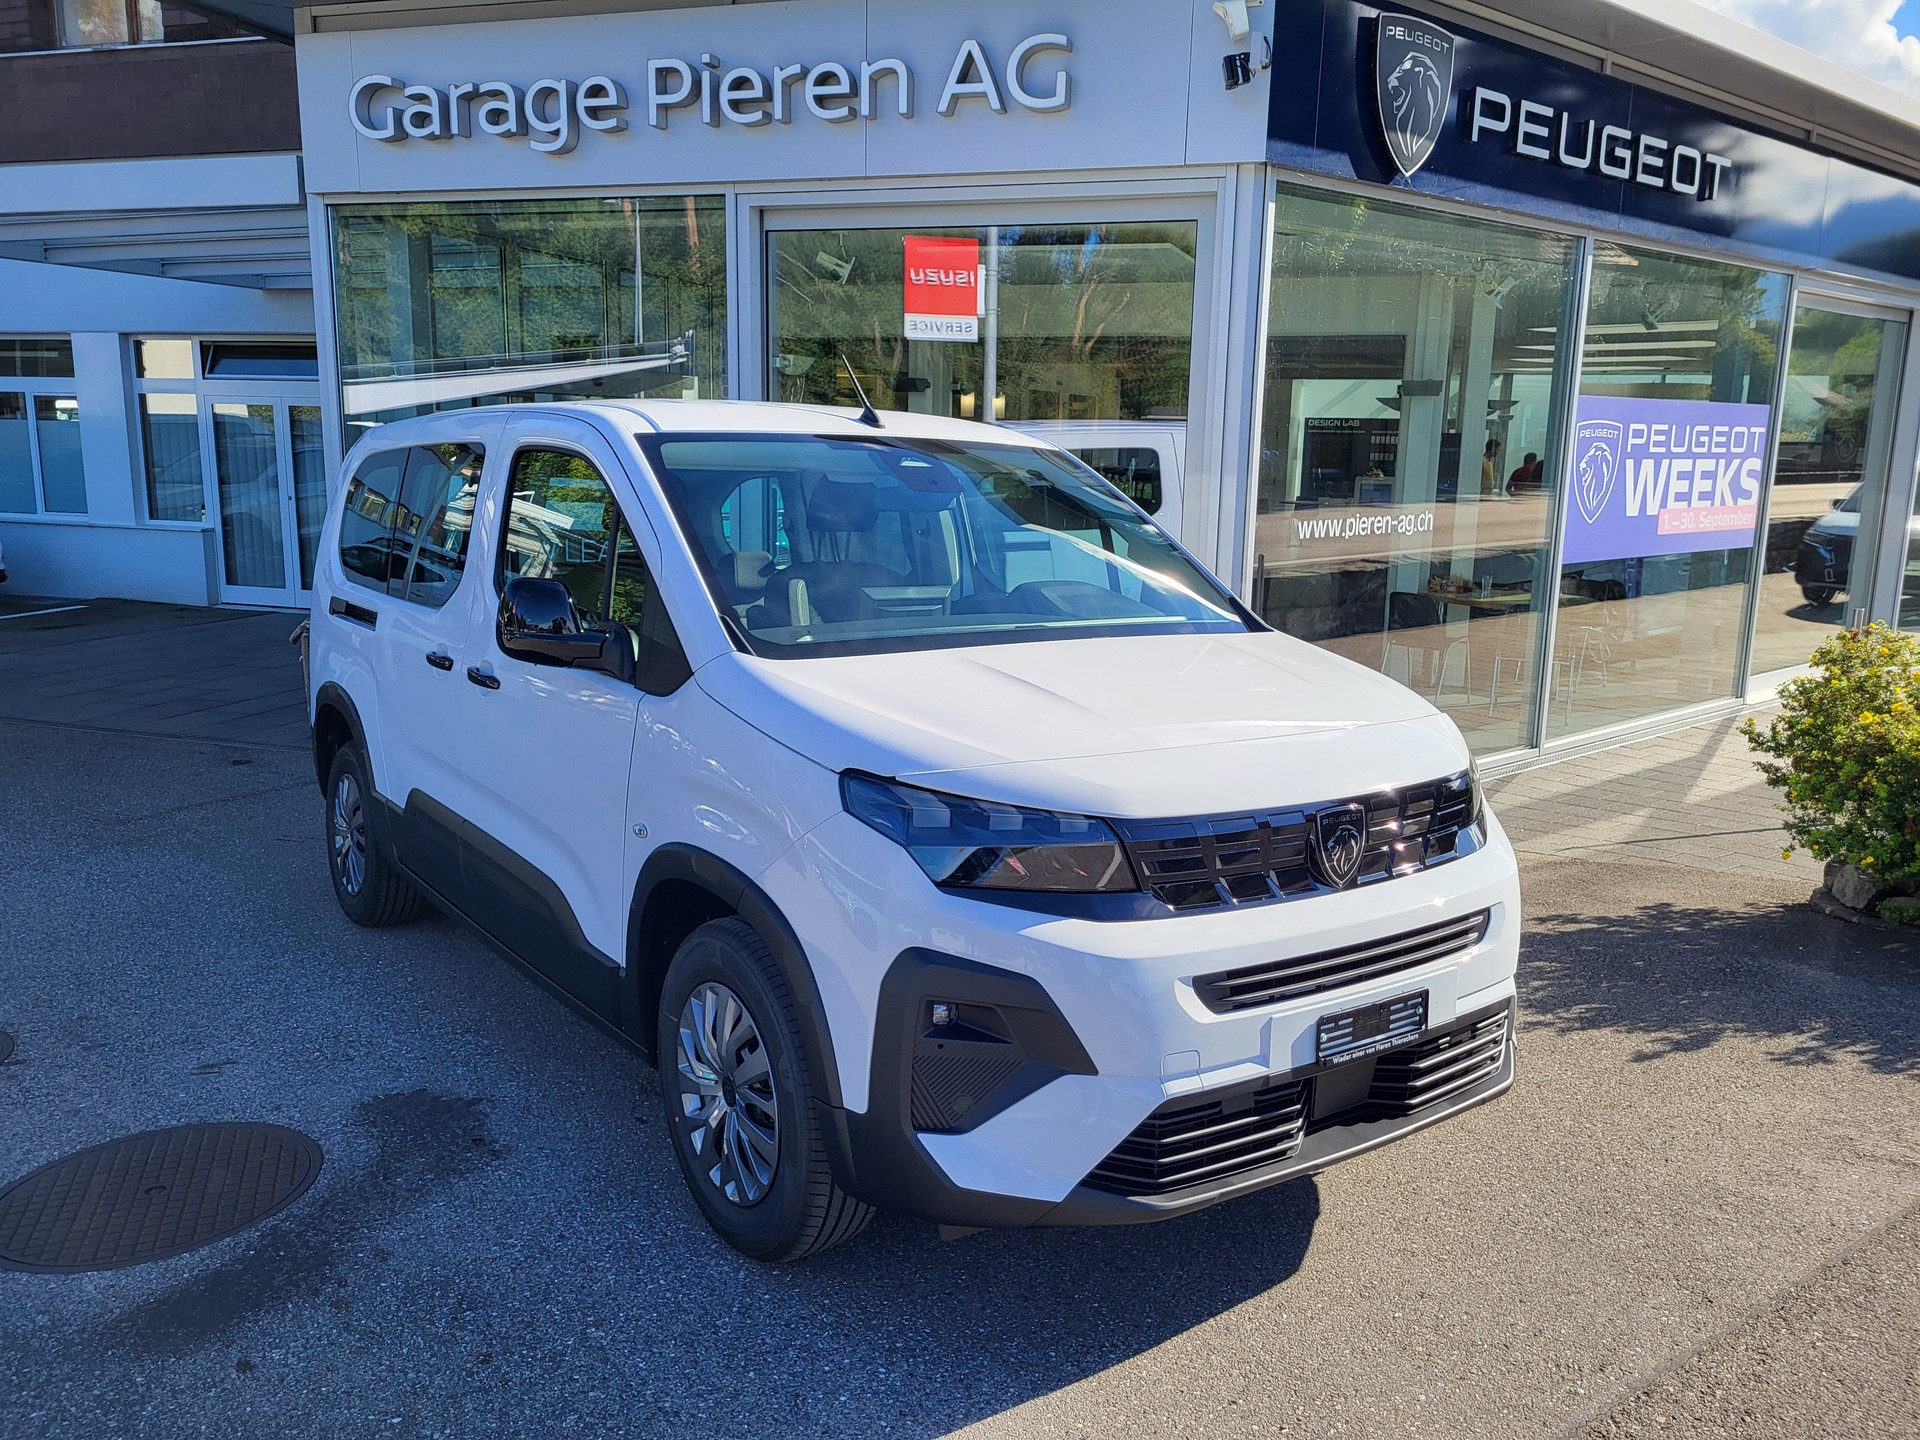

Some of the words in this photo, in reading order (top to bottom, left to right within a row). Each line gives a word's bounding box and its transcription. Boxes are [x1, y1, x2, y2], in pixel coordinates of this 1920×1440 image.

[1385, 25, 1450, 55] PEUGEOT
[348, 74, 628, 154] Garage
[647, 53, 914, 130] Pieren
[936, 33, 1072, 117] AG
[1471, 86, 1732, 200] PEUGEOT
[1308, 419, 1340, 427] DESIGN
[1579, 428, 1619, 439] PEUGEOT
[1626, 423, 1765, 453] PEUGEOT
[1625, 458, 1762, 517] WEEKS
[1298, 510, 1434, 540] www.pieren-ag.ch
[1699, 510, 1753, 530] September
[1323, 814, 1361, 825] PEUGEOT
[1332, 1054, 1351, 1064] Wieder
[1352, 1049, 1365, 1059] einer
[1366, 1047, 1376, 1055] von
[1376, 1042, 1391, 1052] Pieren
